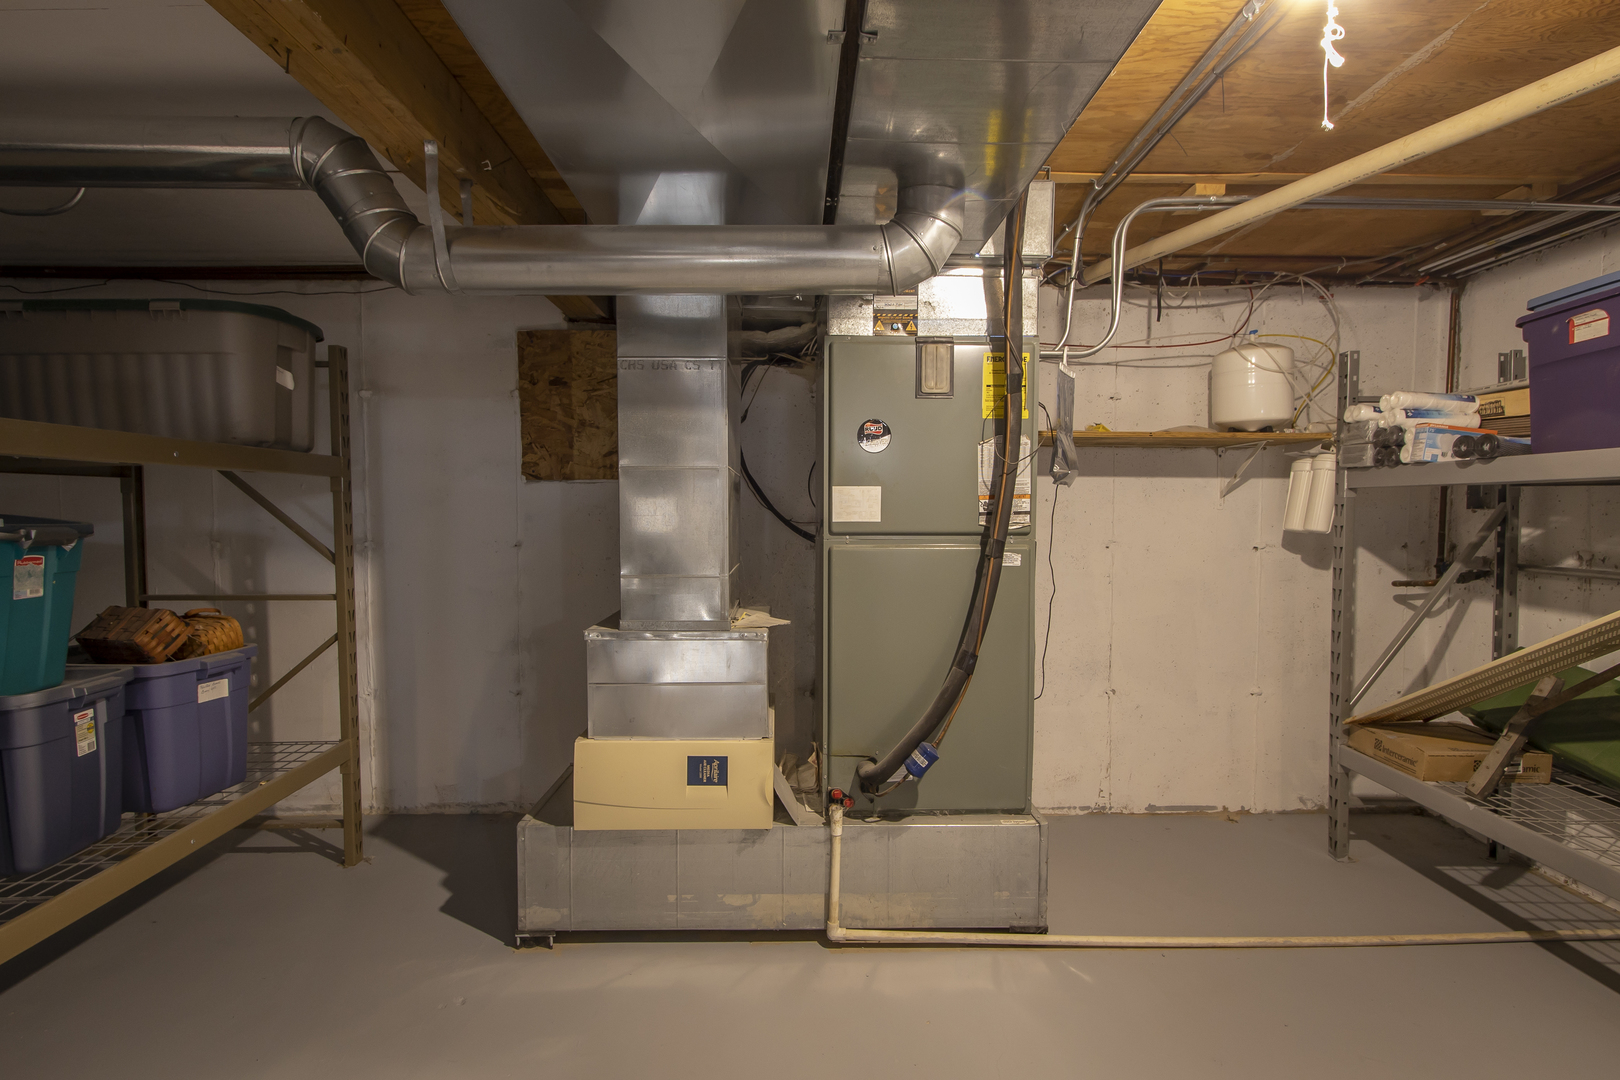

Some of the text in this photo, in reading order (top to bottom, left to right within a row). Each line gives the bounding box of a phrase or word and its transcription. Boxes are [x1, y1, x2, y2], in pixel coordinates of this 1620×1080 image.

[651, 360, 677, 370] USA
[684, 360, 700, 370] CS
[1381, 744, 1417, 767] Interceramic
[711, 758, 720, 783] Aprilaire
